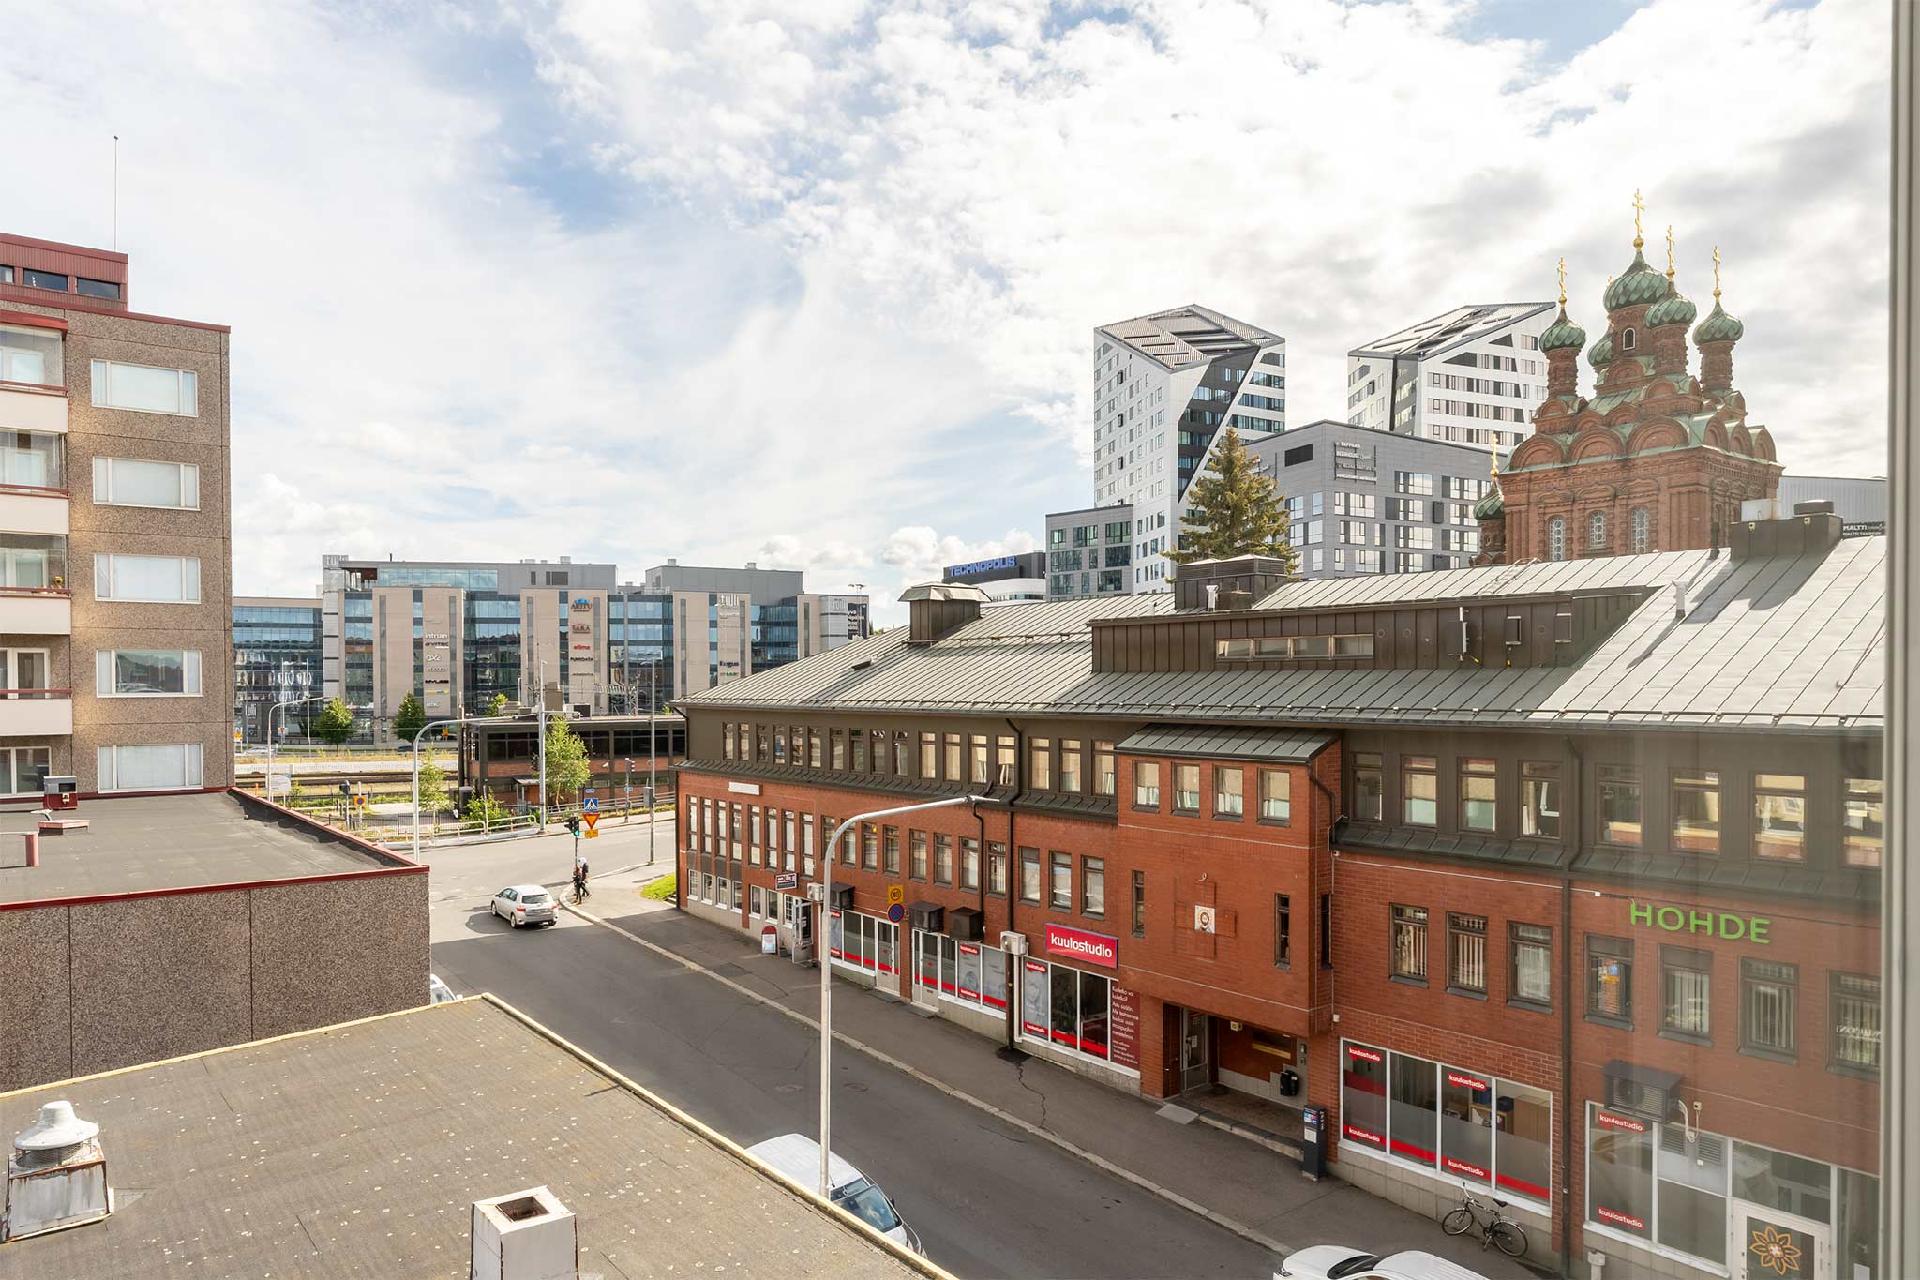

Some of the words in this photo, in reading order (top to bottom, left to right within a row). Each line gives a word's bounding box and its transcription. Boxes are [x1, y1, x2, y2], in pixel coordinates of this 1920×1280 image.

[951, 556, 1016, 577] TECHNOPOLIS
[1630, 903, 1771, 944] HOHDE
[1051, 932, 1113, 958] kuulostudio
[1599, 1114, 1643, 1131] kuulostudio
